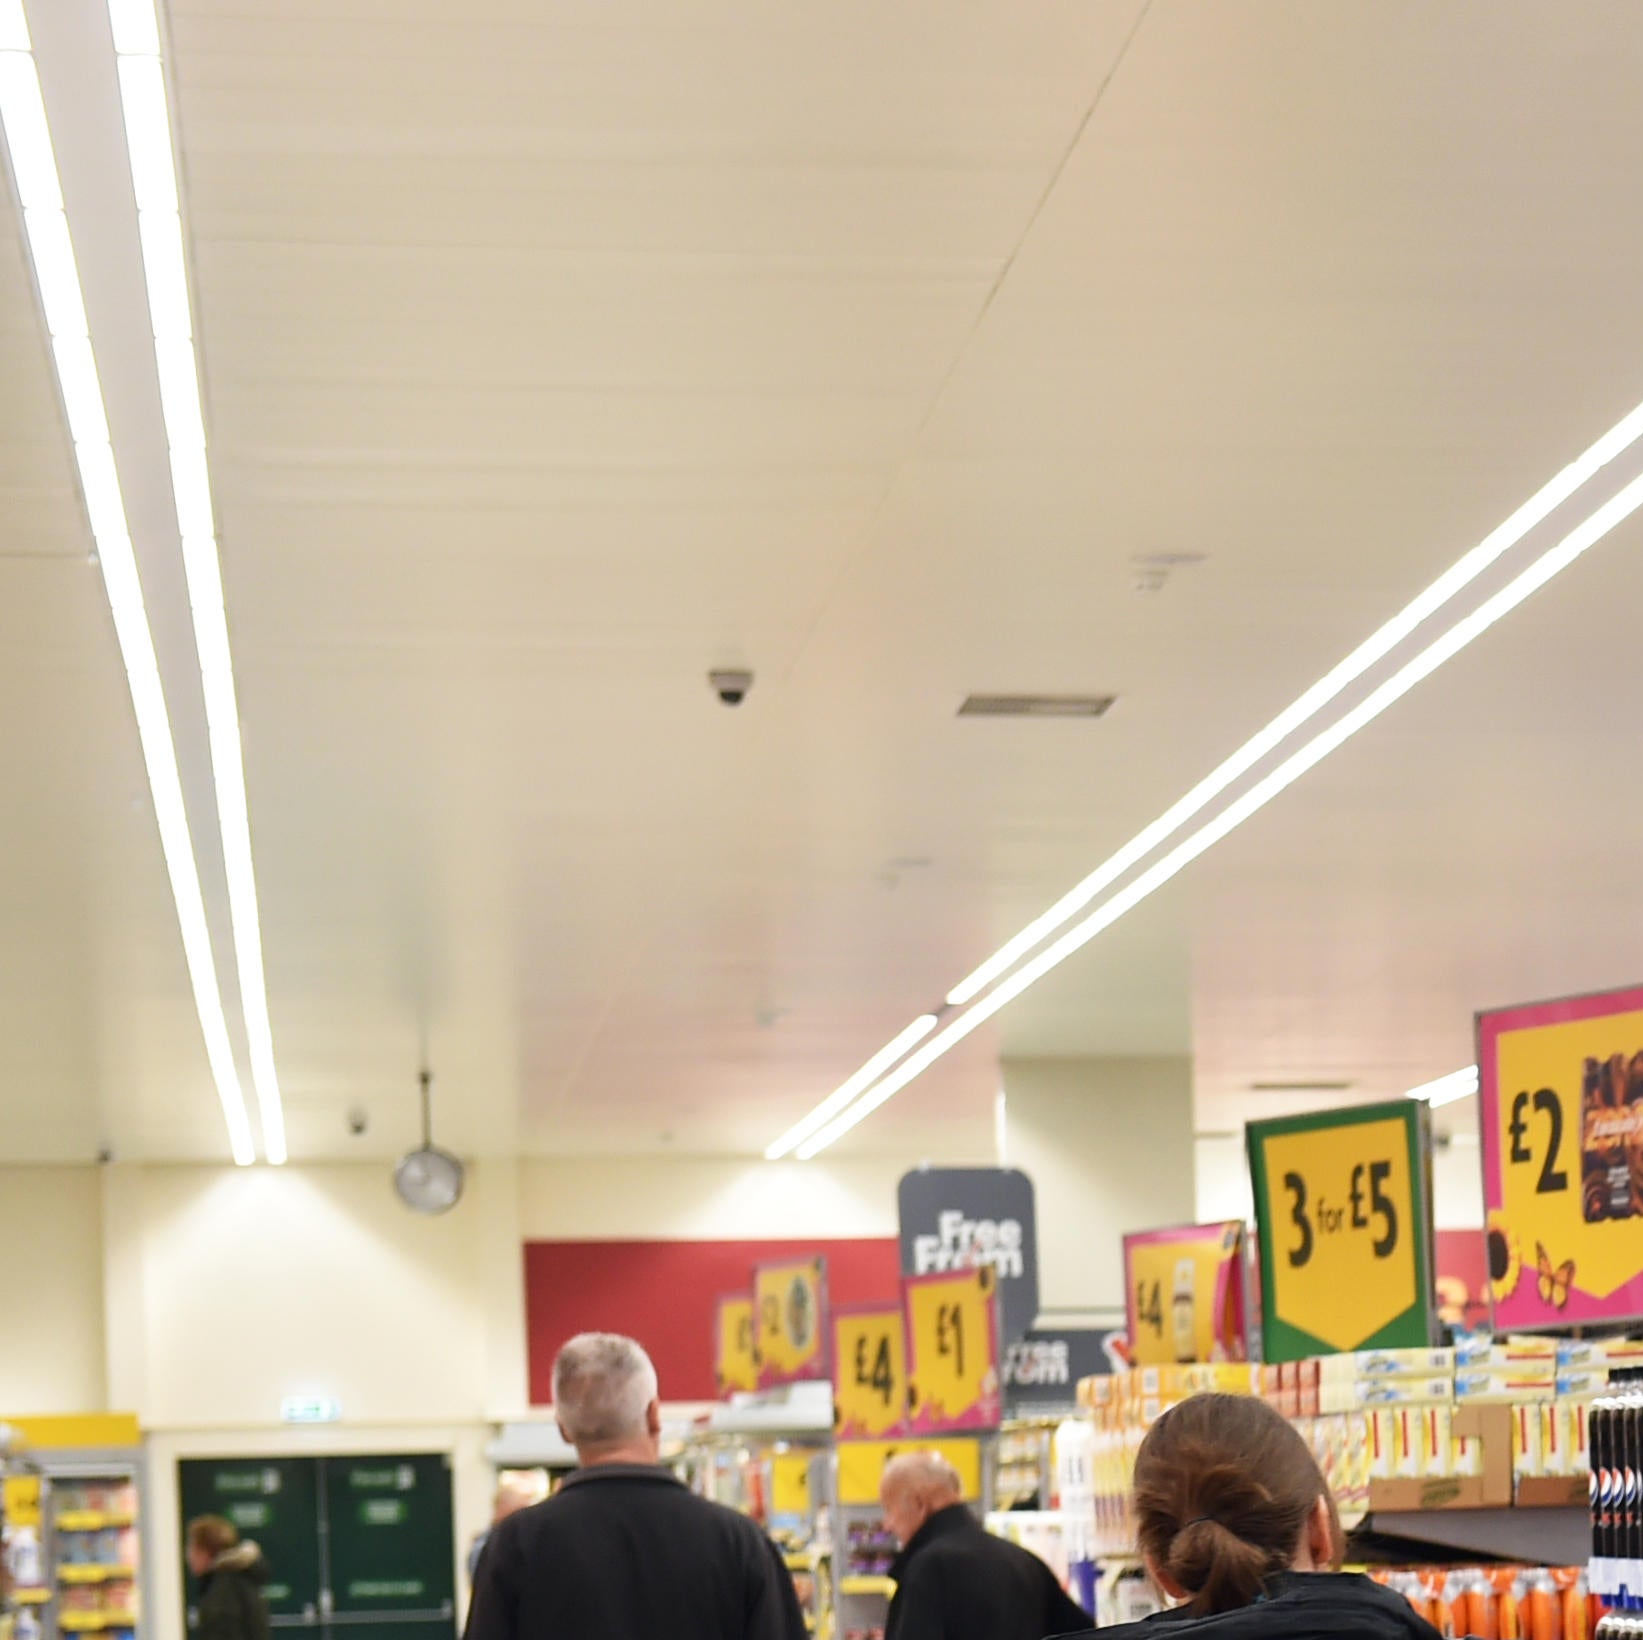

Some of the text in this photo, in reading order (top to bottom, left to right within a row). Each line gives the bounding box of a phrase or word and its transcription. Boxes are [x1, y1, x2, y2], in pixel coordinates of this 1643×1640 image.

[1509, 1088, 1568, 1194] £2
[939, 1210, 1022, 1249] Free
[1283, 1159, 1396, 1268] 3 for £5
[914, 1234, 1024, 1278] From
[936, 1302, 964, 1379] £1
[1138, 1280, 1162, 1338] £4
[856, 1333, 891, 1405] £4
